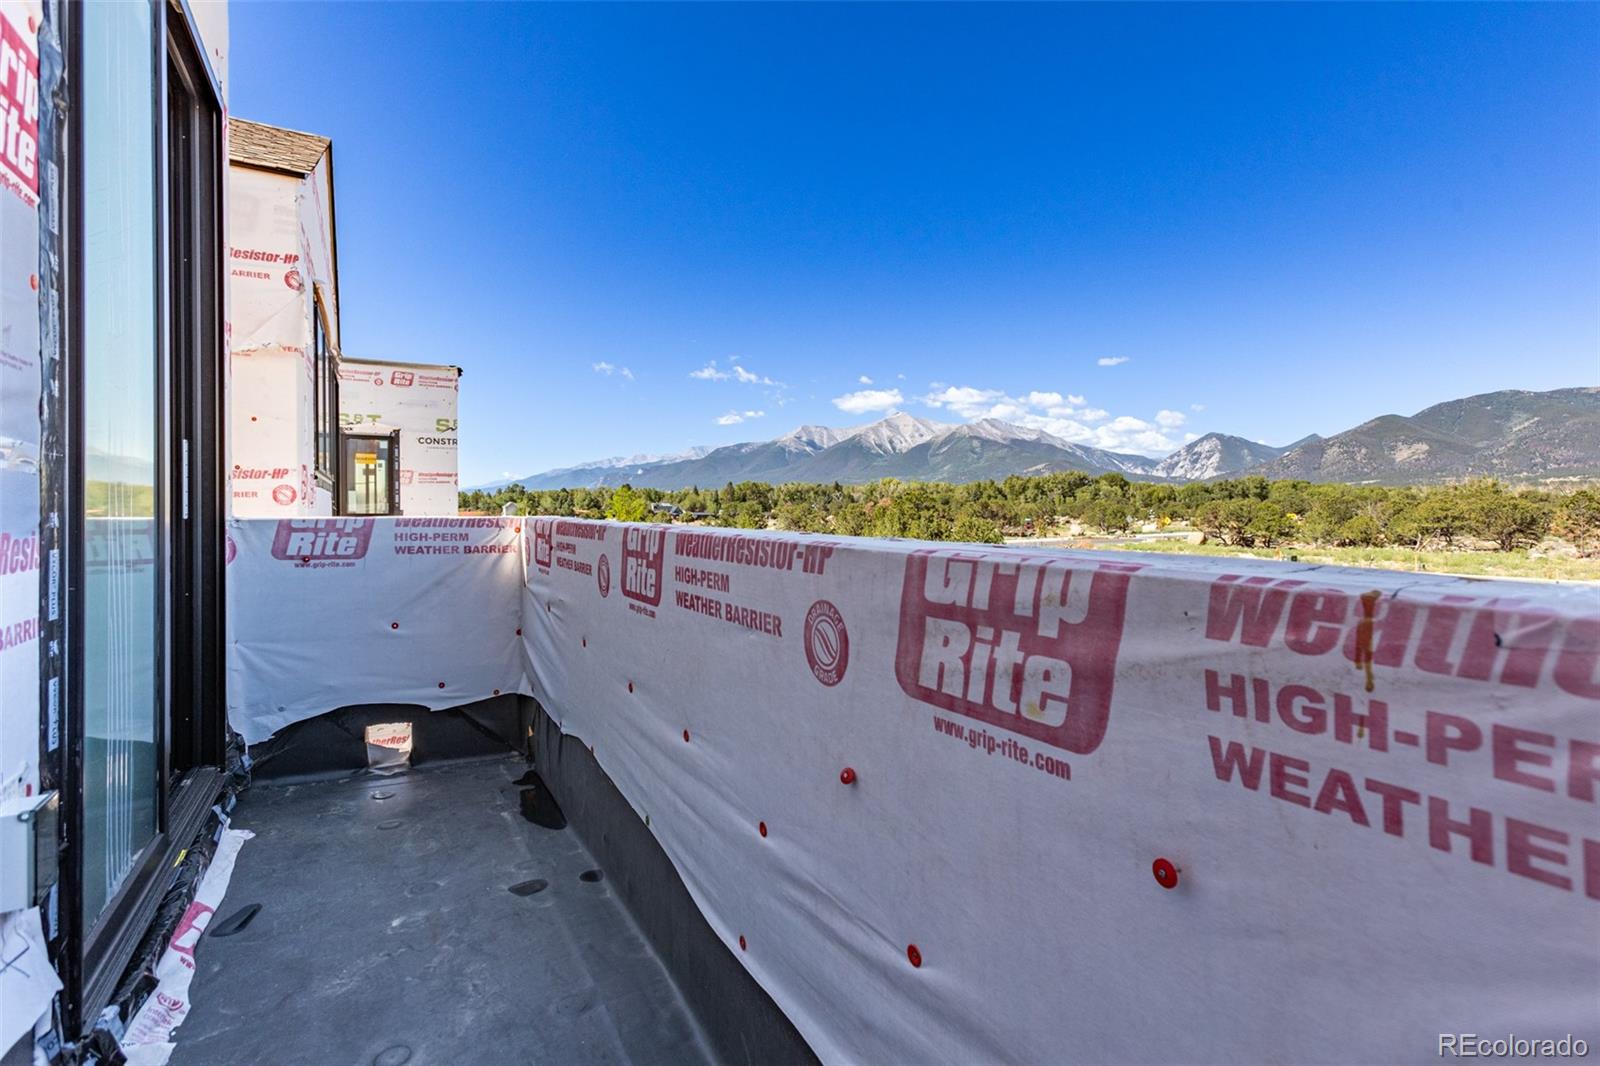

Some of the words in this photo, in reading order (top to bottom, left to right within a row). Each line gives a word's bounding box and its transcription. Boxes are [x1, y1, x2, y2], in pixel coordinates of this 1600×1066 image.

[286, 532, 358, 556] Rite
[395, 533, 469, 542] HIGH-PERM
[395, 545, 459, 555] WEATHER
[464, 544, 518, 554] BARRIER
[626, 557, 657, 599] Rite
[675, 565, 730, 593] HIGH-PERM
[675, 590, 722, 620] WEATHER
[725, 603, 783, 638] BARRIER
[807, 602, 845, 633] DRAINAGE
[813, 666, 840, 684] GRADE
[918, 615, 1073, 729] Rite
[933, 715, 1073, 781] www.grip-rite.com
[1208, 735, 1600, 902] WEATHE
